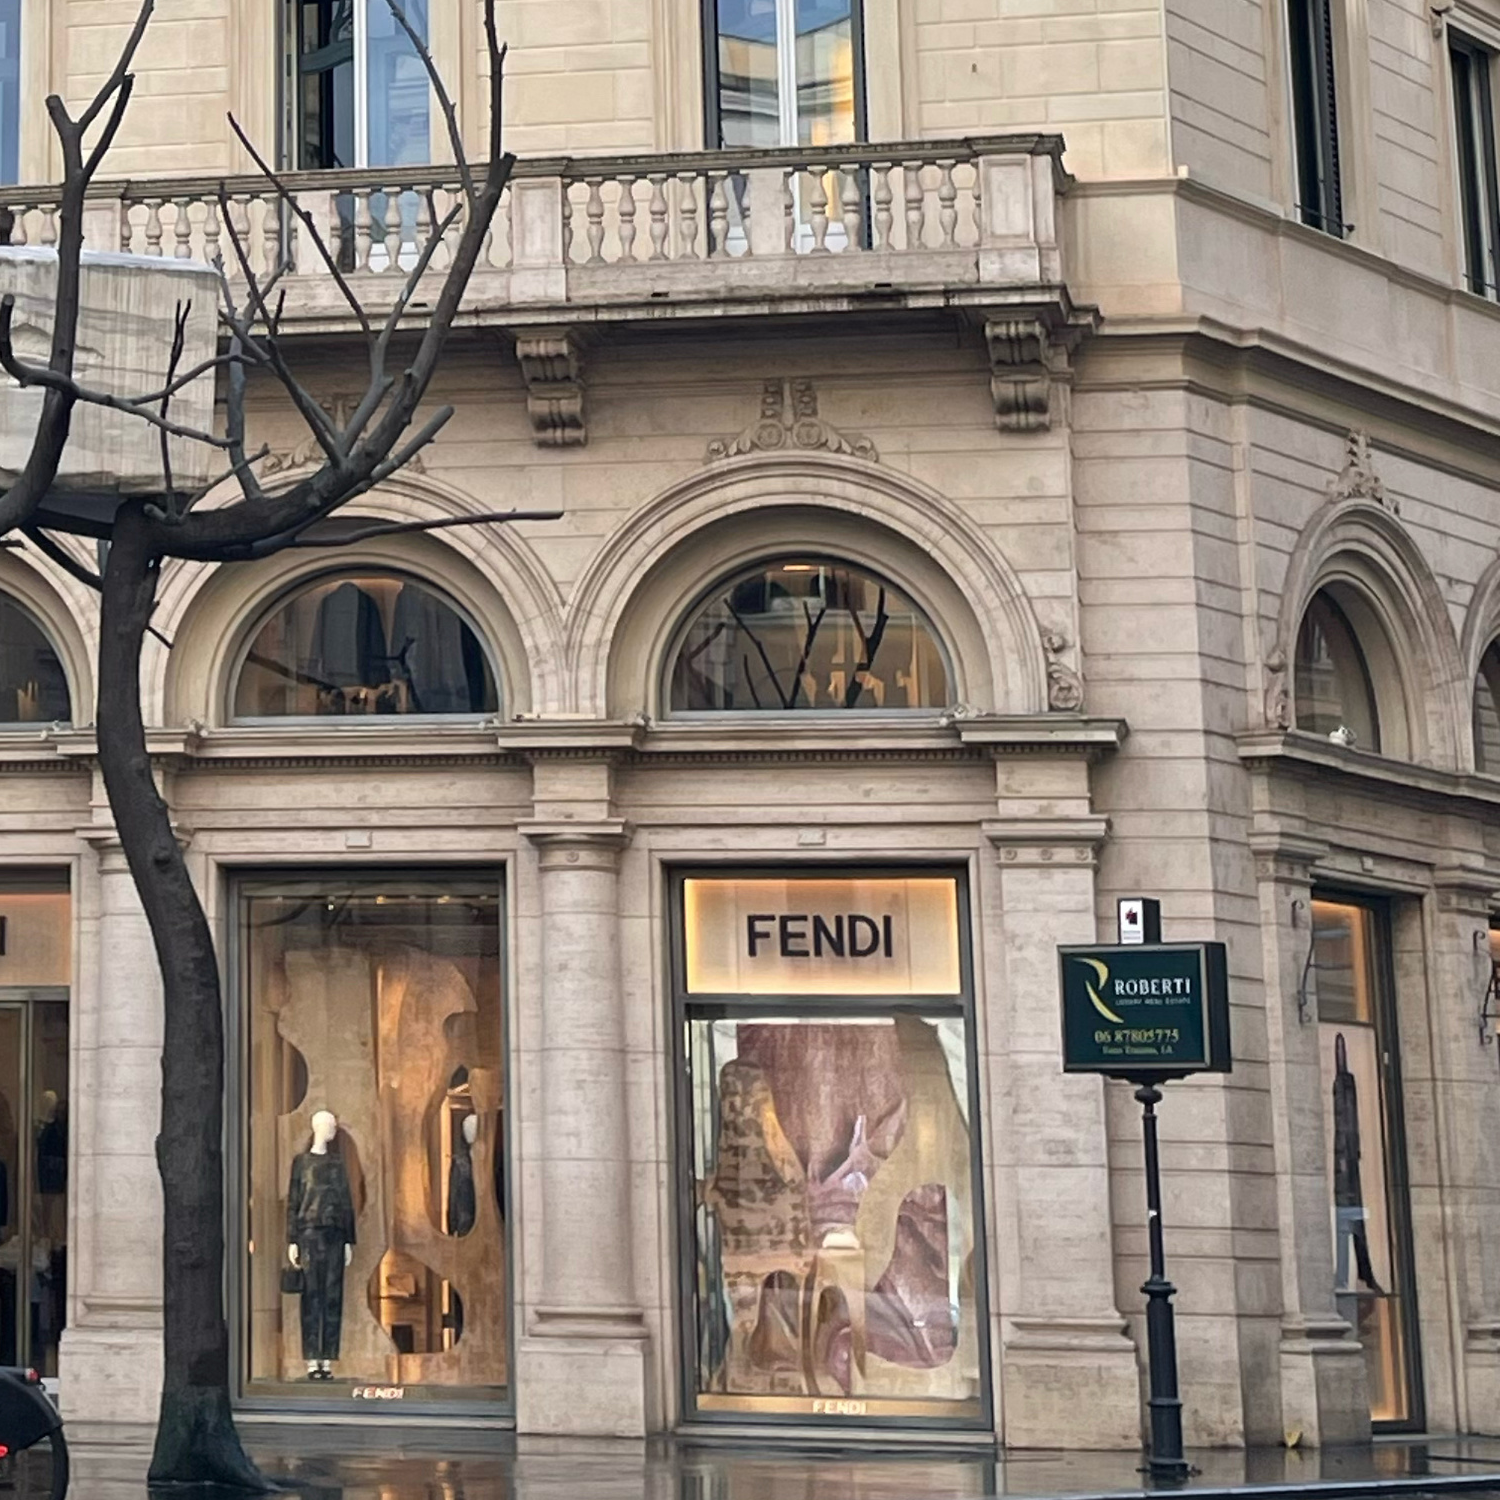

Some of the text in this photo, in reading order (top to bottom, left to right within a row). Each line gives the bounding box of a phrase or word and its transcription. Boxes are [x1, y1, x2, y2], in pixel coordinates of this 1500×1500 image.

[747, 915, 892, 958] FENDI
[1114, 977, 1191, 996] ROBERTI
[352, 1386, 405, 1399] FENDI
[813, 1399, 867, 1415] FENDI
